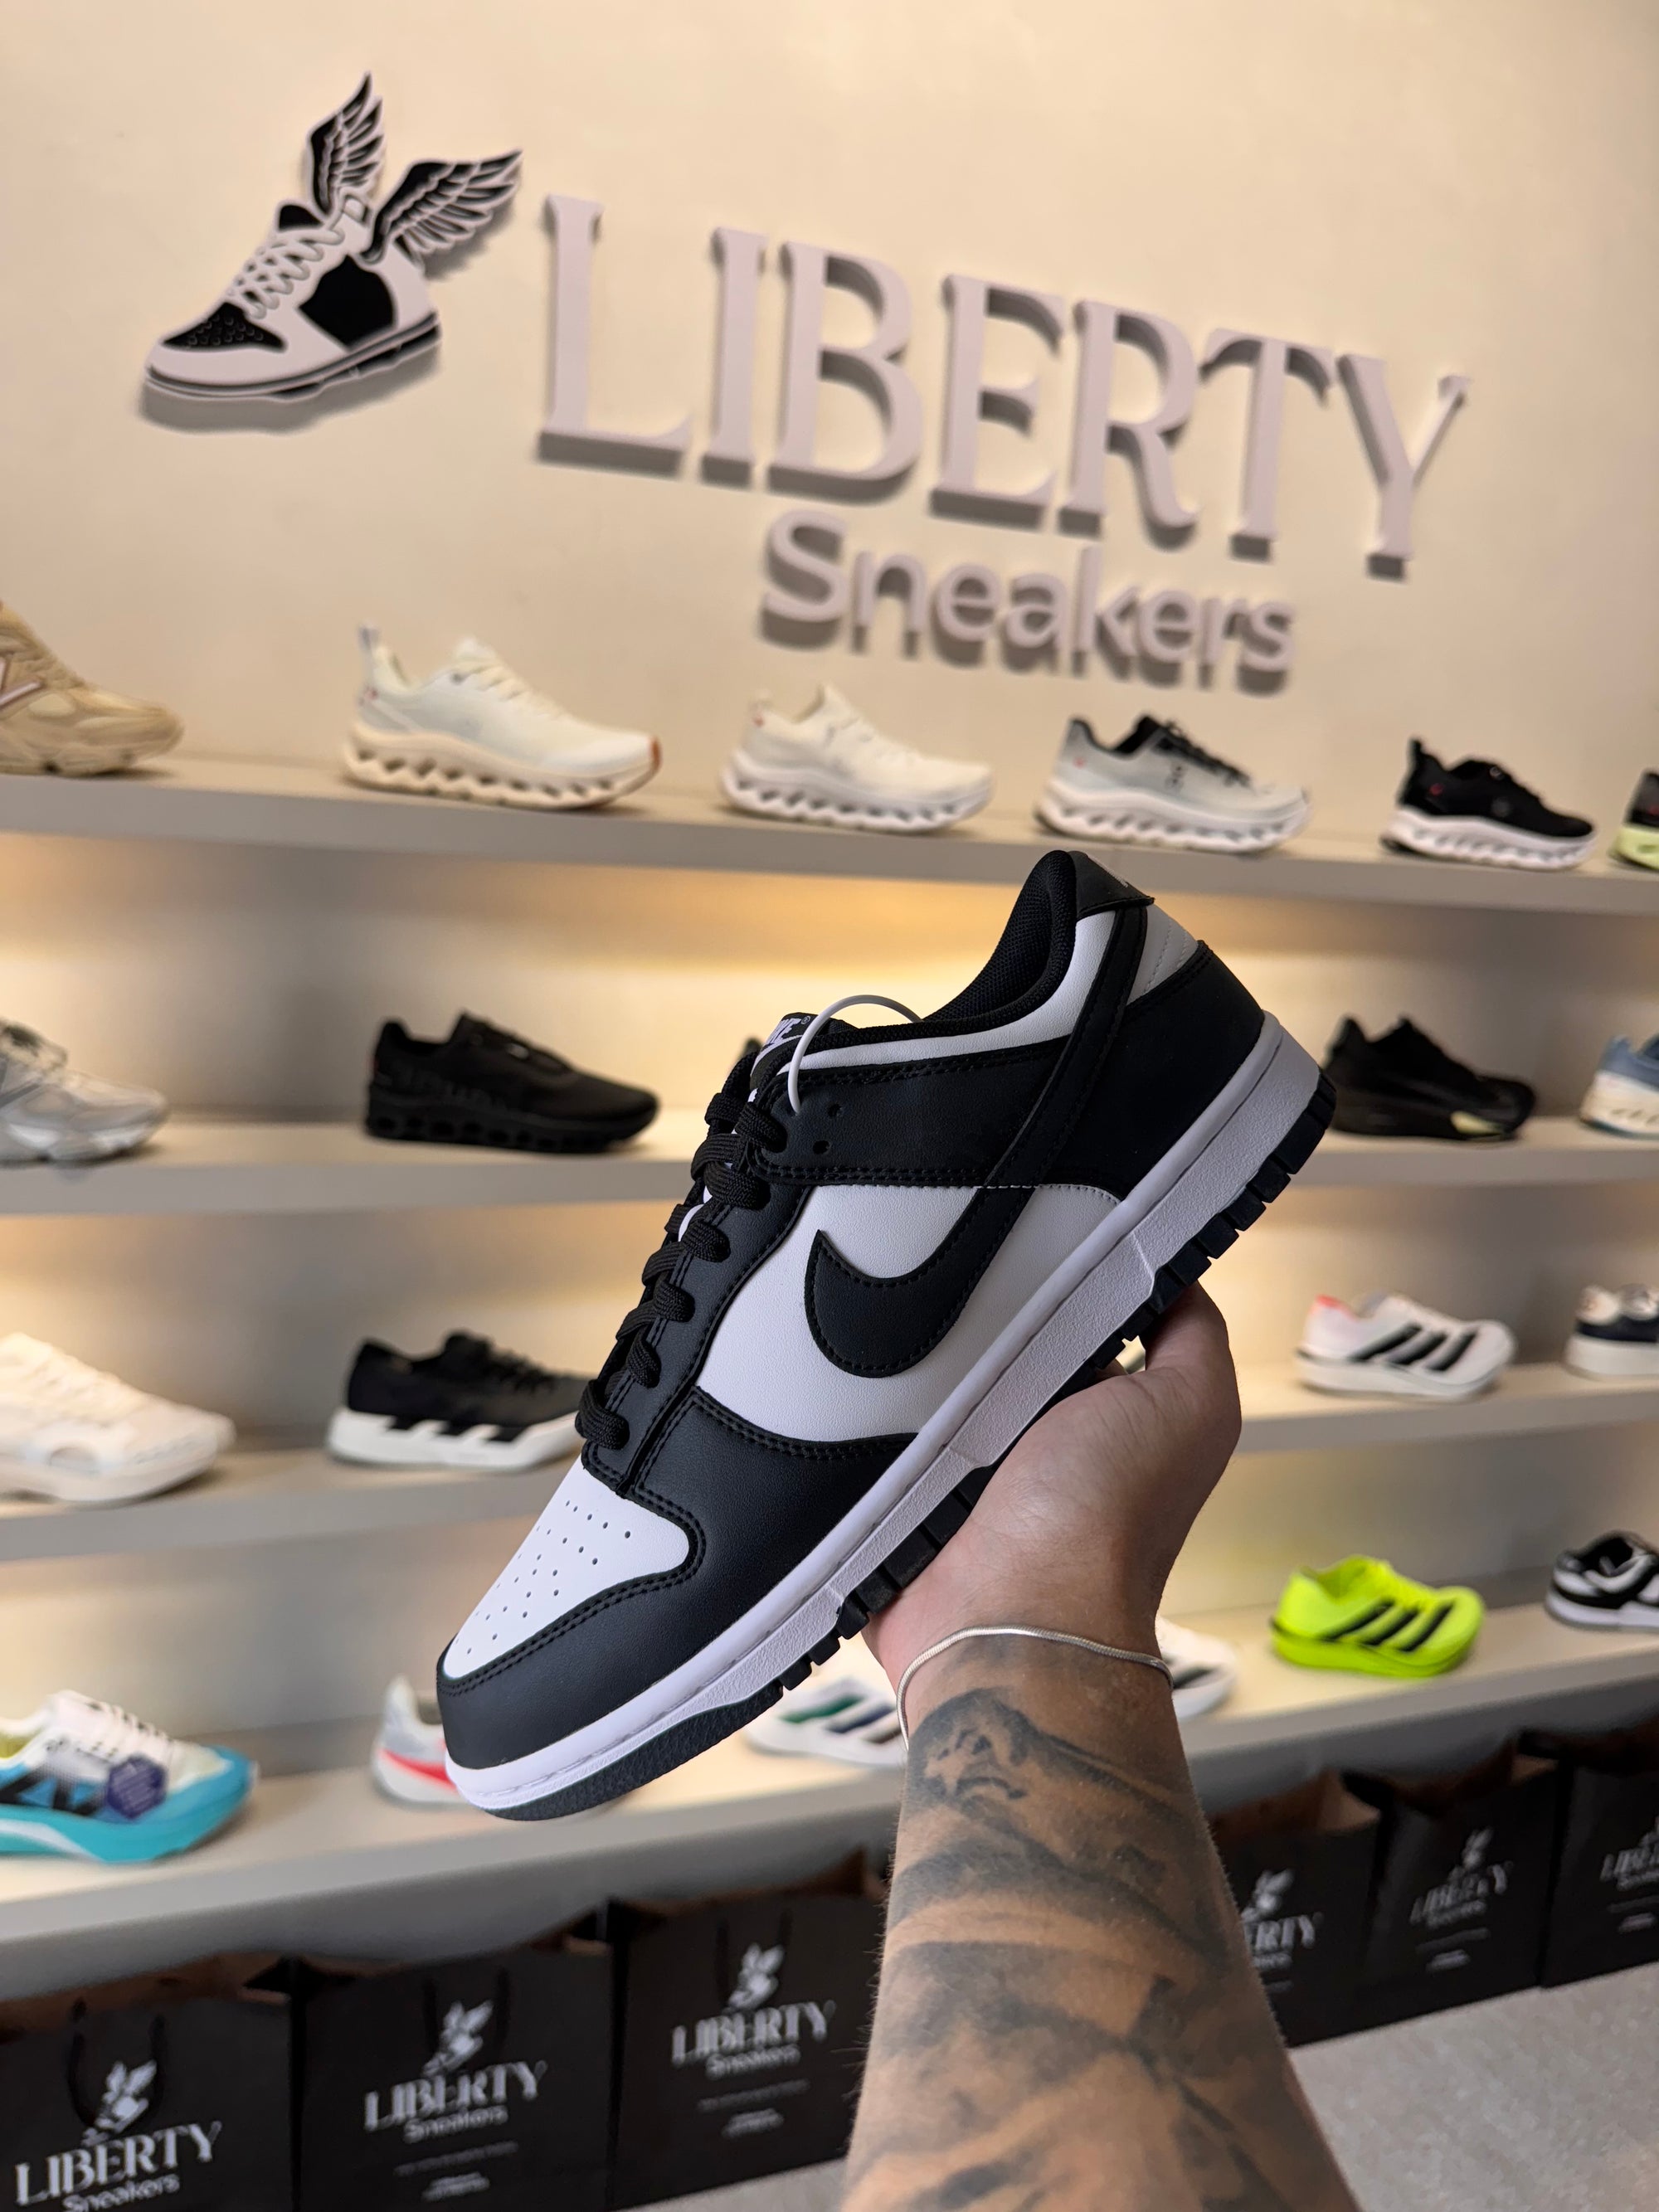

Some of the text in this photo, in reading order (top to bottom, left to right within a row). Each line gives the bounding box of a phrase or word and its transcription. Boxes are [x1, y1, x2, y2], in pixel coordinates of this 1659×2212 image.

[538, 194, 1471, 571] LIBERTY
[763, 508, 1296, 678] Sneakers
[671, 2000, 836, 2068] LIBERTY
[363, 2060, 547, 2132] LIBERTY
[14, 2120, 223, 2206] LIBERTY
[63, 2173, 180, 2212] Sneakers
